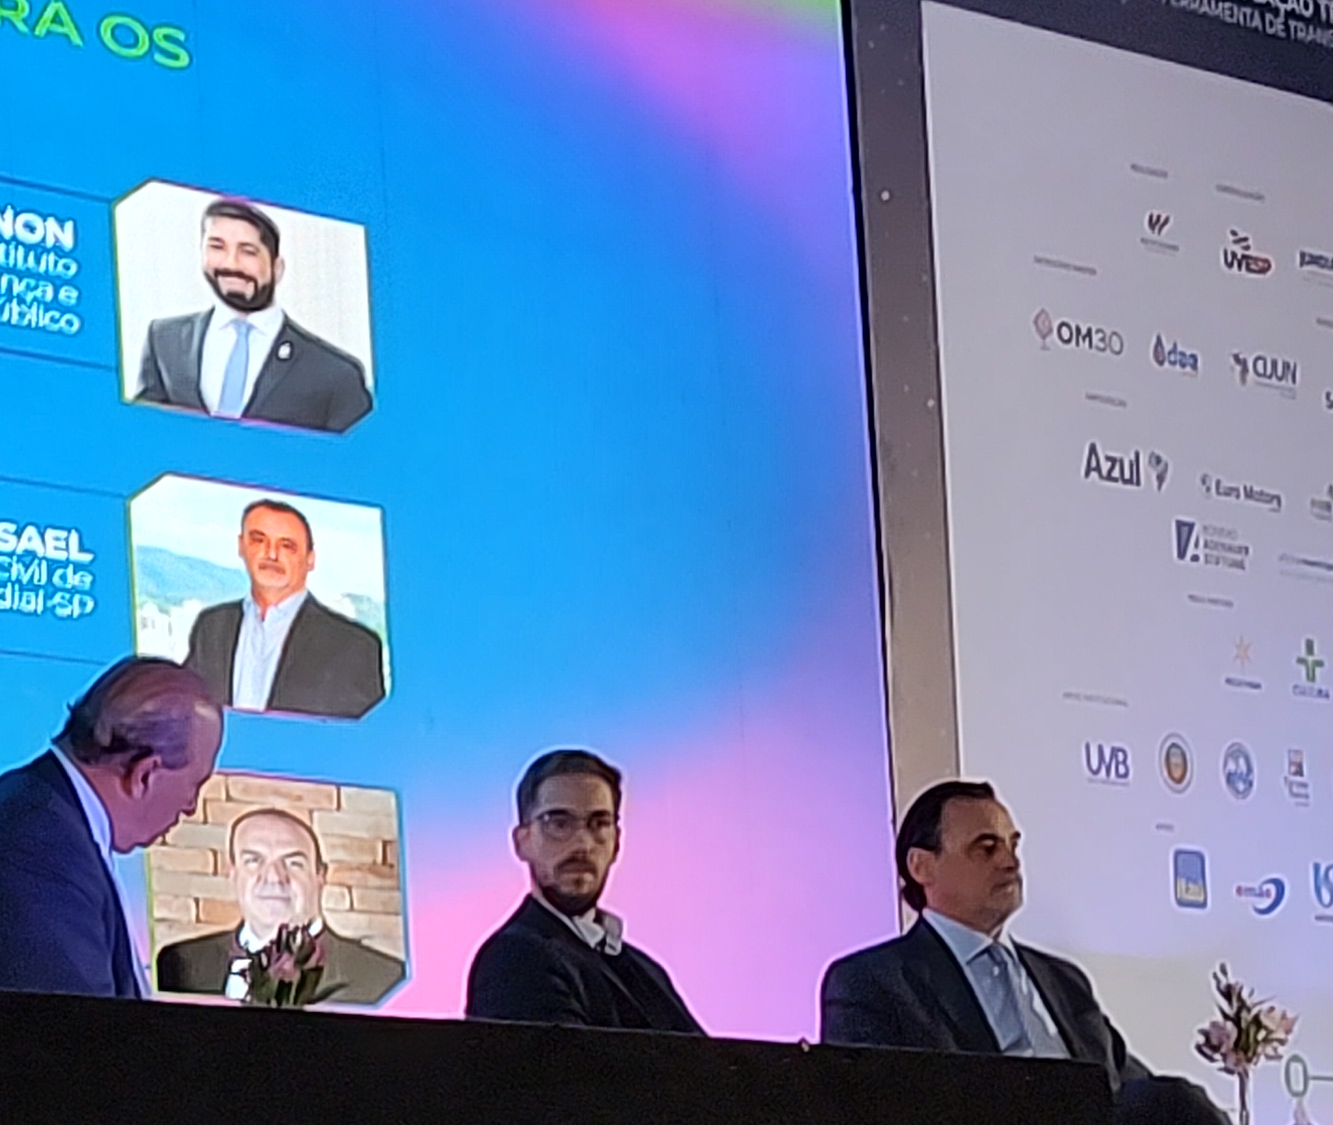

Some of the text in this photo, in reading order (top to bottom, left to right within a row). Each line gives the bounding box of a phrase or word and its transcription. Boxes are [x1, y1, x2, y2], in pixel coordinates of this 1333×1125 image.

[98, 14, 193, 69] OS
[57, 285, 79, 306] e
[1056, 320, 1124, 356] OM30
[1084, 442, 1142, 488] Azul
[51, 563, 94, 590] de
[1084, 740, 1131, 779] UVB
